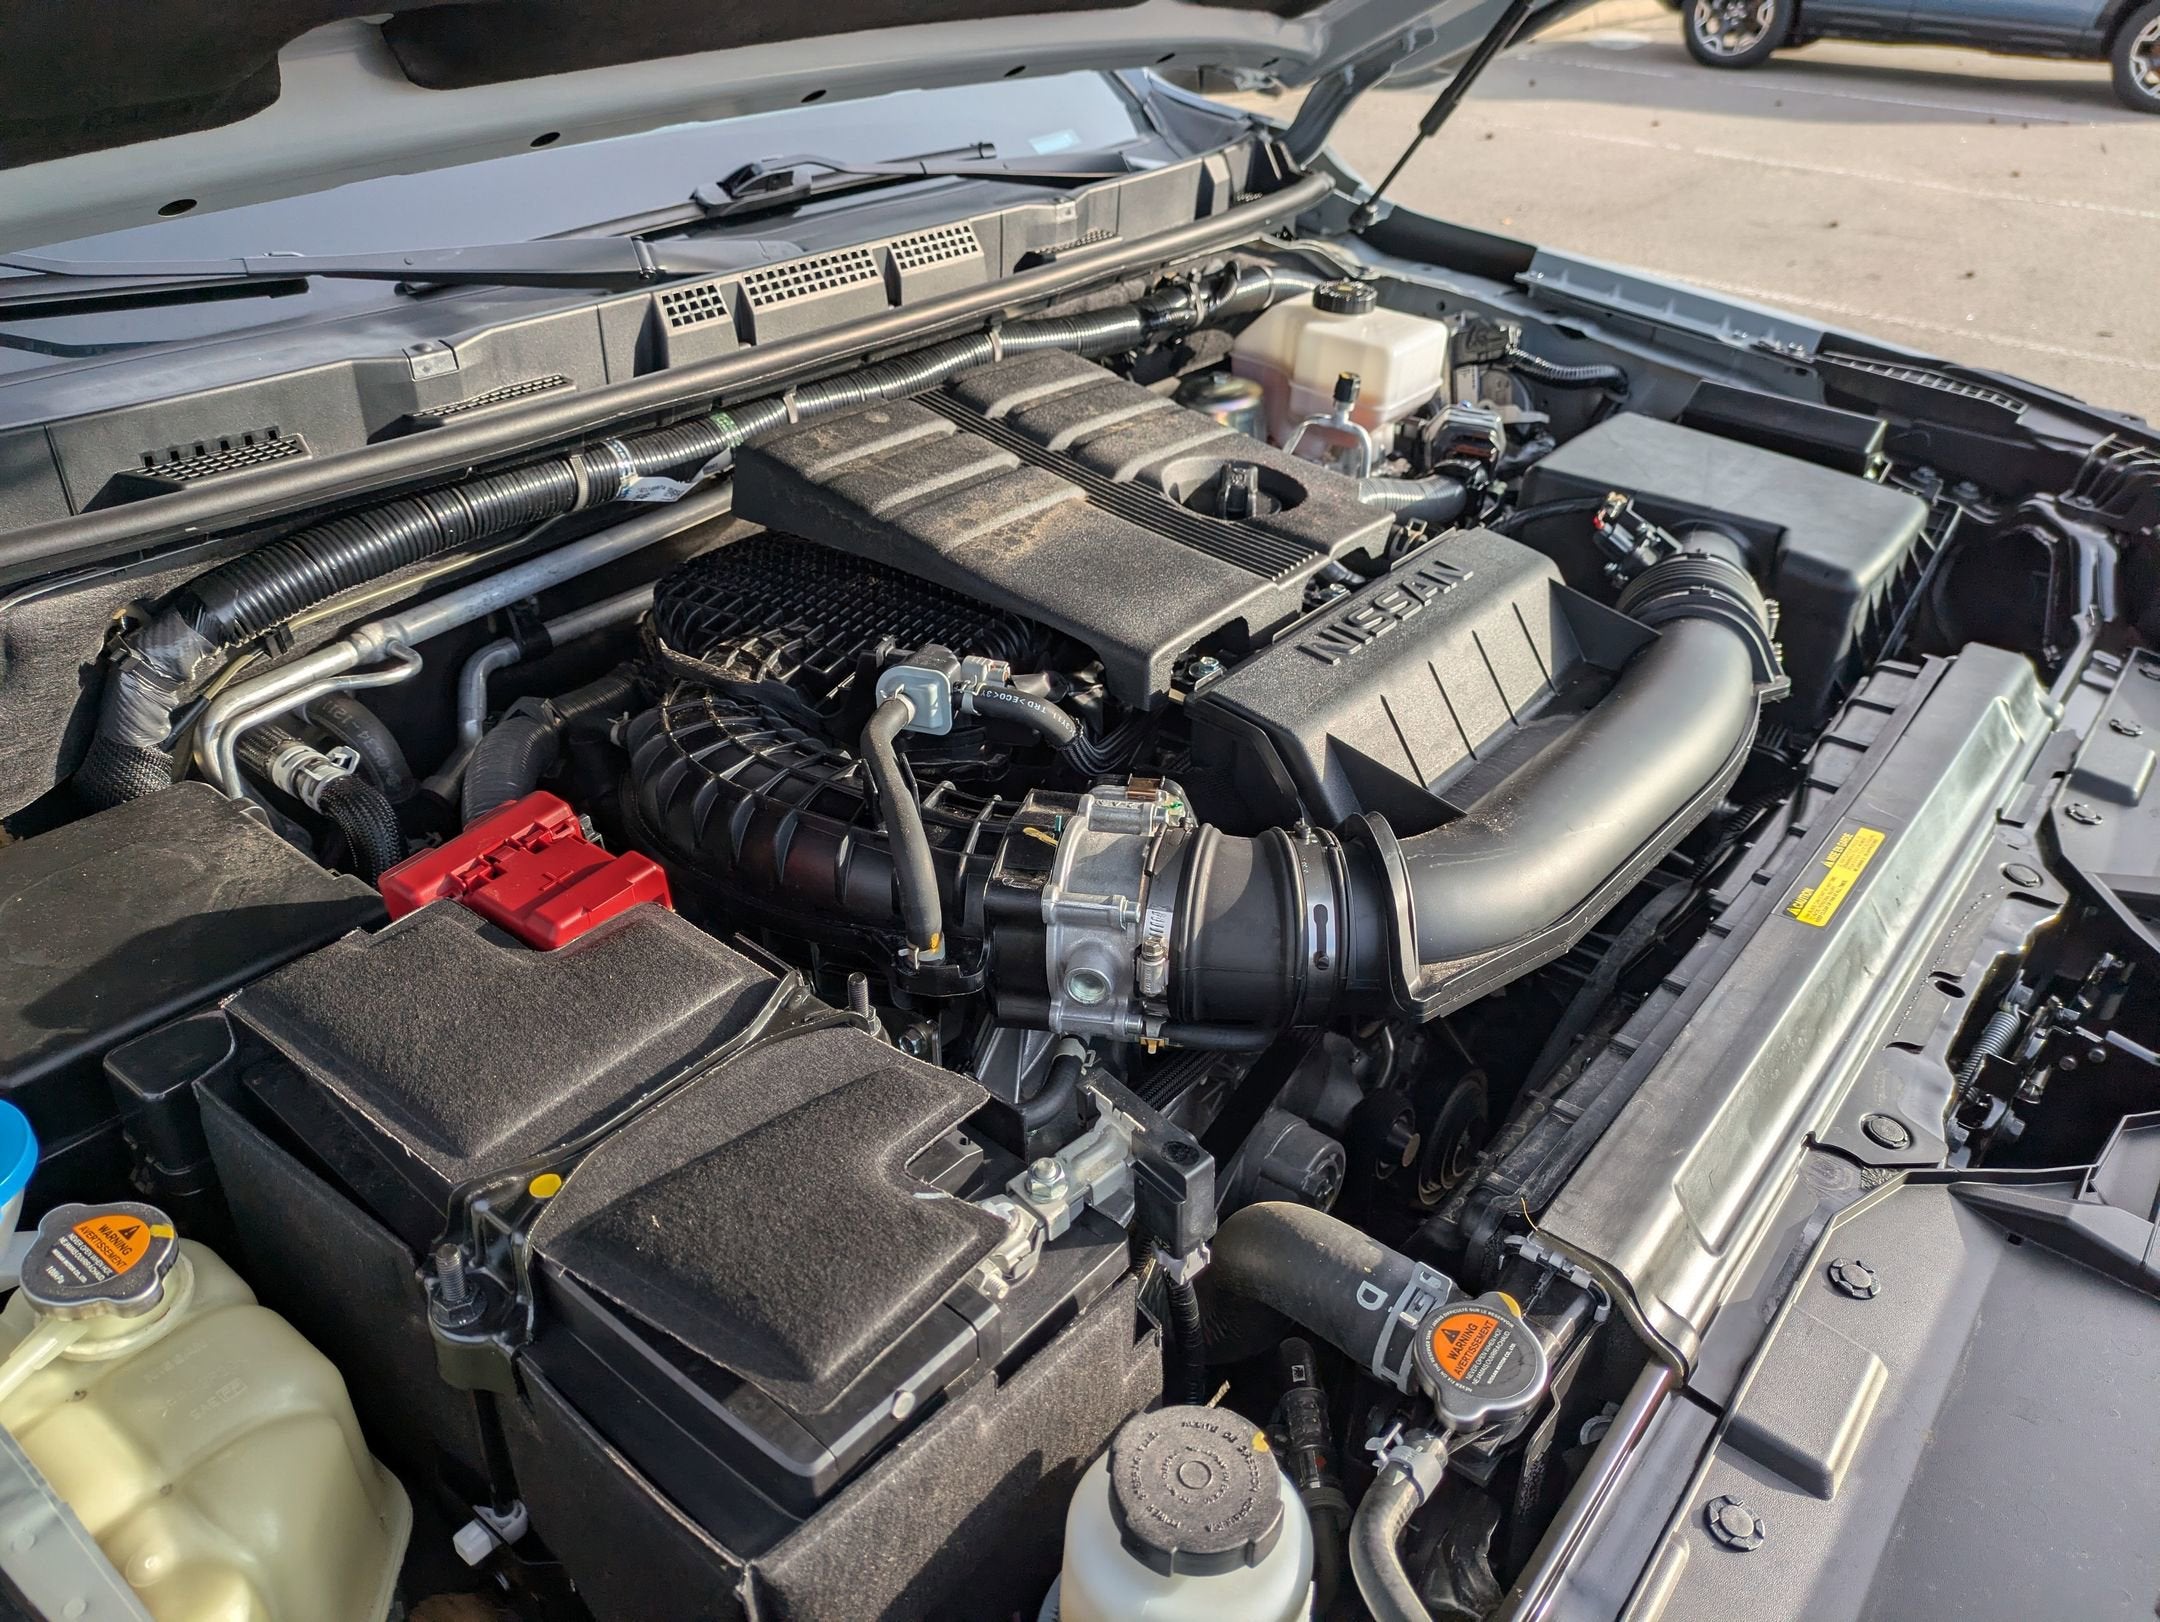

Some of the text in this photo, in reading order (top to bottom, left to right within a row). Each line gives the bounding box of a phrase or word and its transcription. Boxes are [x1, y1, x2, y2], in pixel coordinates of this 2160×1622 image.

[1298, 560, 1474, 666] NISSAN
[1027, 701, 1047, 714] TRD
[1792, 887, 1814, 908] CAUTION
[67, 1232, 83, 1247] NEVER
[79, 1244, 93, 1257] OPEN
[79, 1225, 127, 1269] AVERTISSEMENT
[98, 1223, 133, 1256] WARNING
[1356, 1280, 1389, 1311] D
[1448, 1321, 1477, 1360] WARNING
[1453, 1319, 1493, 1375] AVERTISSEMENT
[1465, 1364, 1478, 1380] NEVER
[1475, 1351, 1486, 1365] OPEN
[1483, 1337, 1496, 1352] WHEN
[1476, 1363, 1489, 1379] JAMAIS
[1486, 1369, 1498, 1384] NISSAN
[1495, 1356, 1507, 1370] MOTOR
